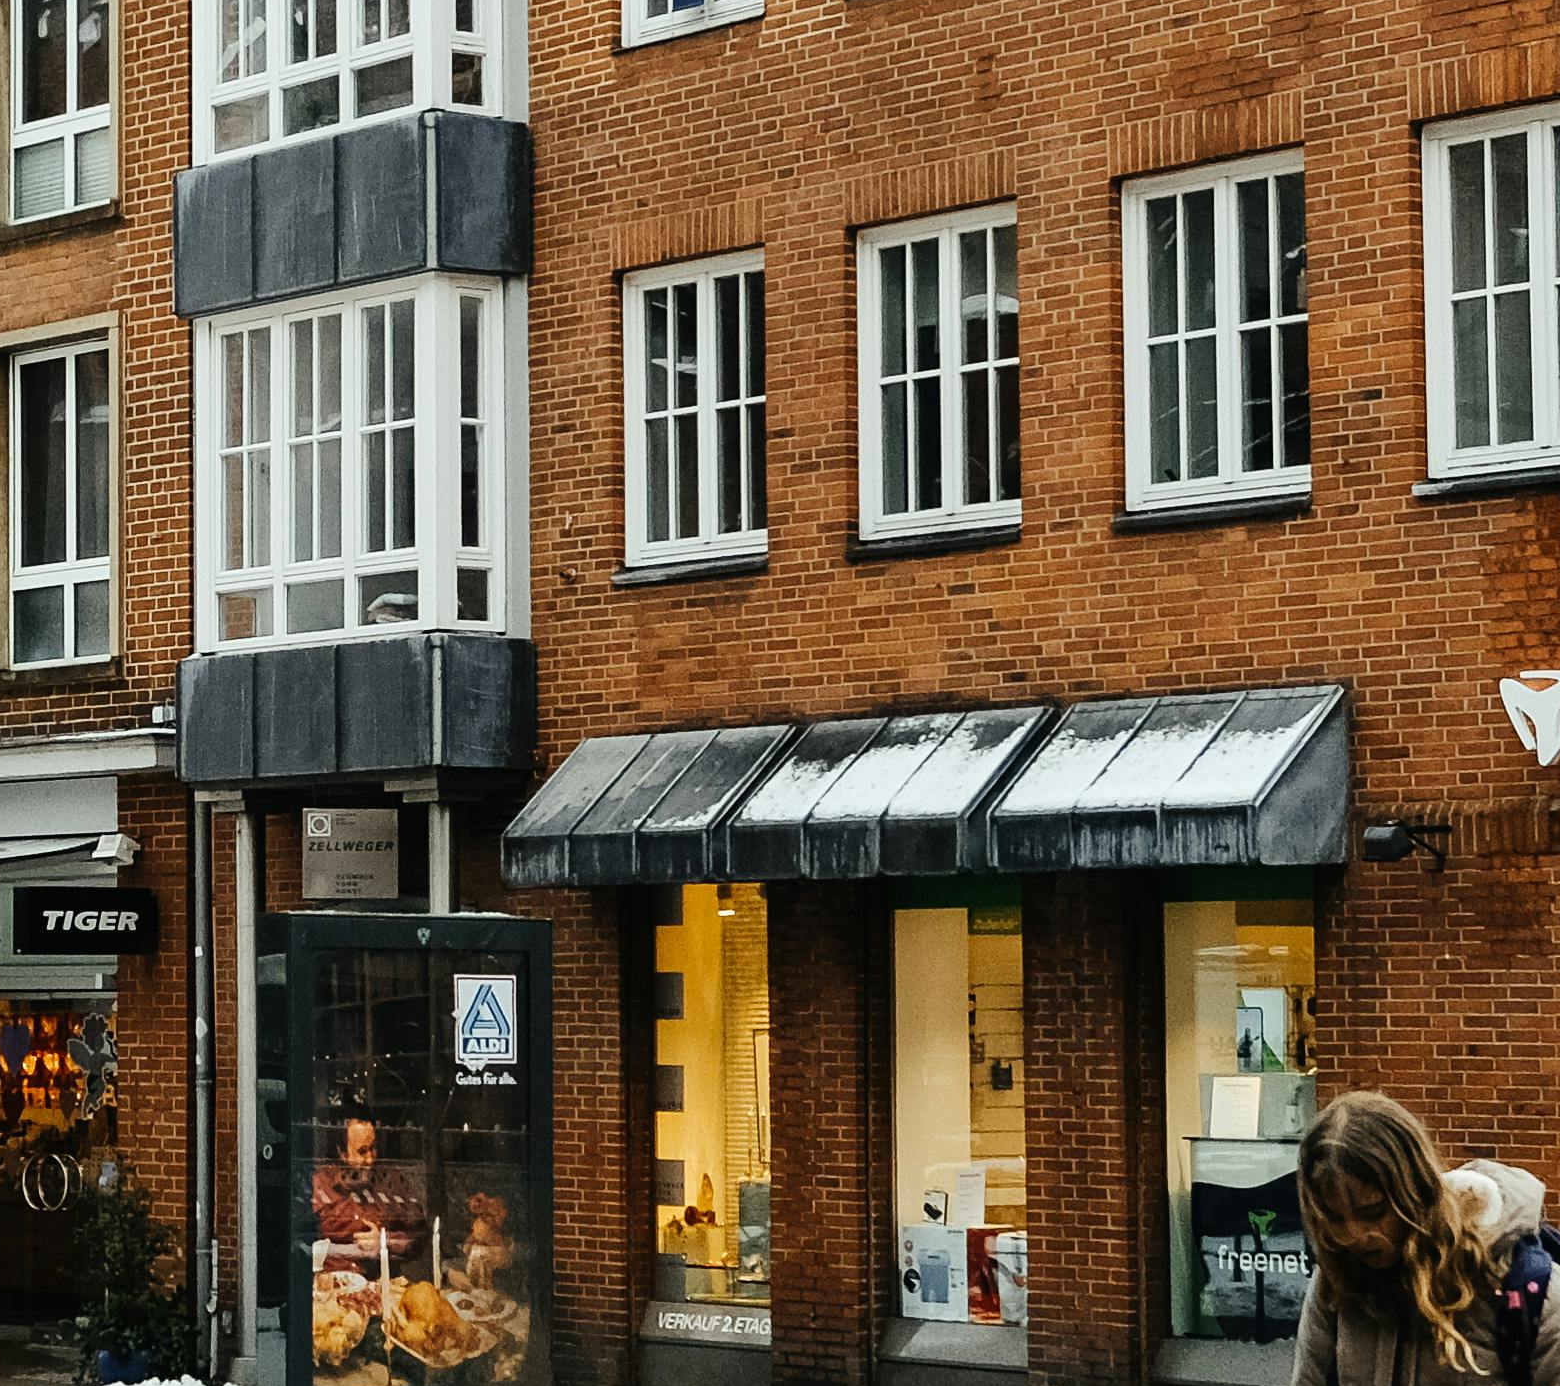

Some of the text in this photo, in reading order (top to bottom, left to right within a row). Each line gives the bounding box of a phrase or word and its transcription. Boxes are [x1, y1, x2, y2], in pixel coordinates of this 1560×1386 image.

[307, 840, 395, 852] ZELLWEGER
[42, 910, 140, 931] TIGER
[466, 1037, 507, 1053] ALDI
[455, 1071, 482, 1085] Gutes
[483, 1071, 498, 1085] für
[1217, 1243, 1310, 1276] freenet
[658, 1311, 723, 1332] VERKAUF
